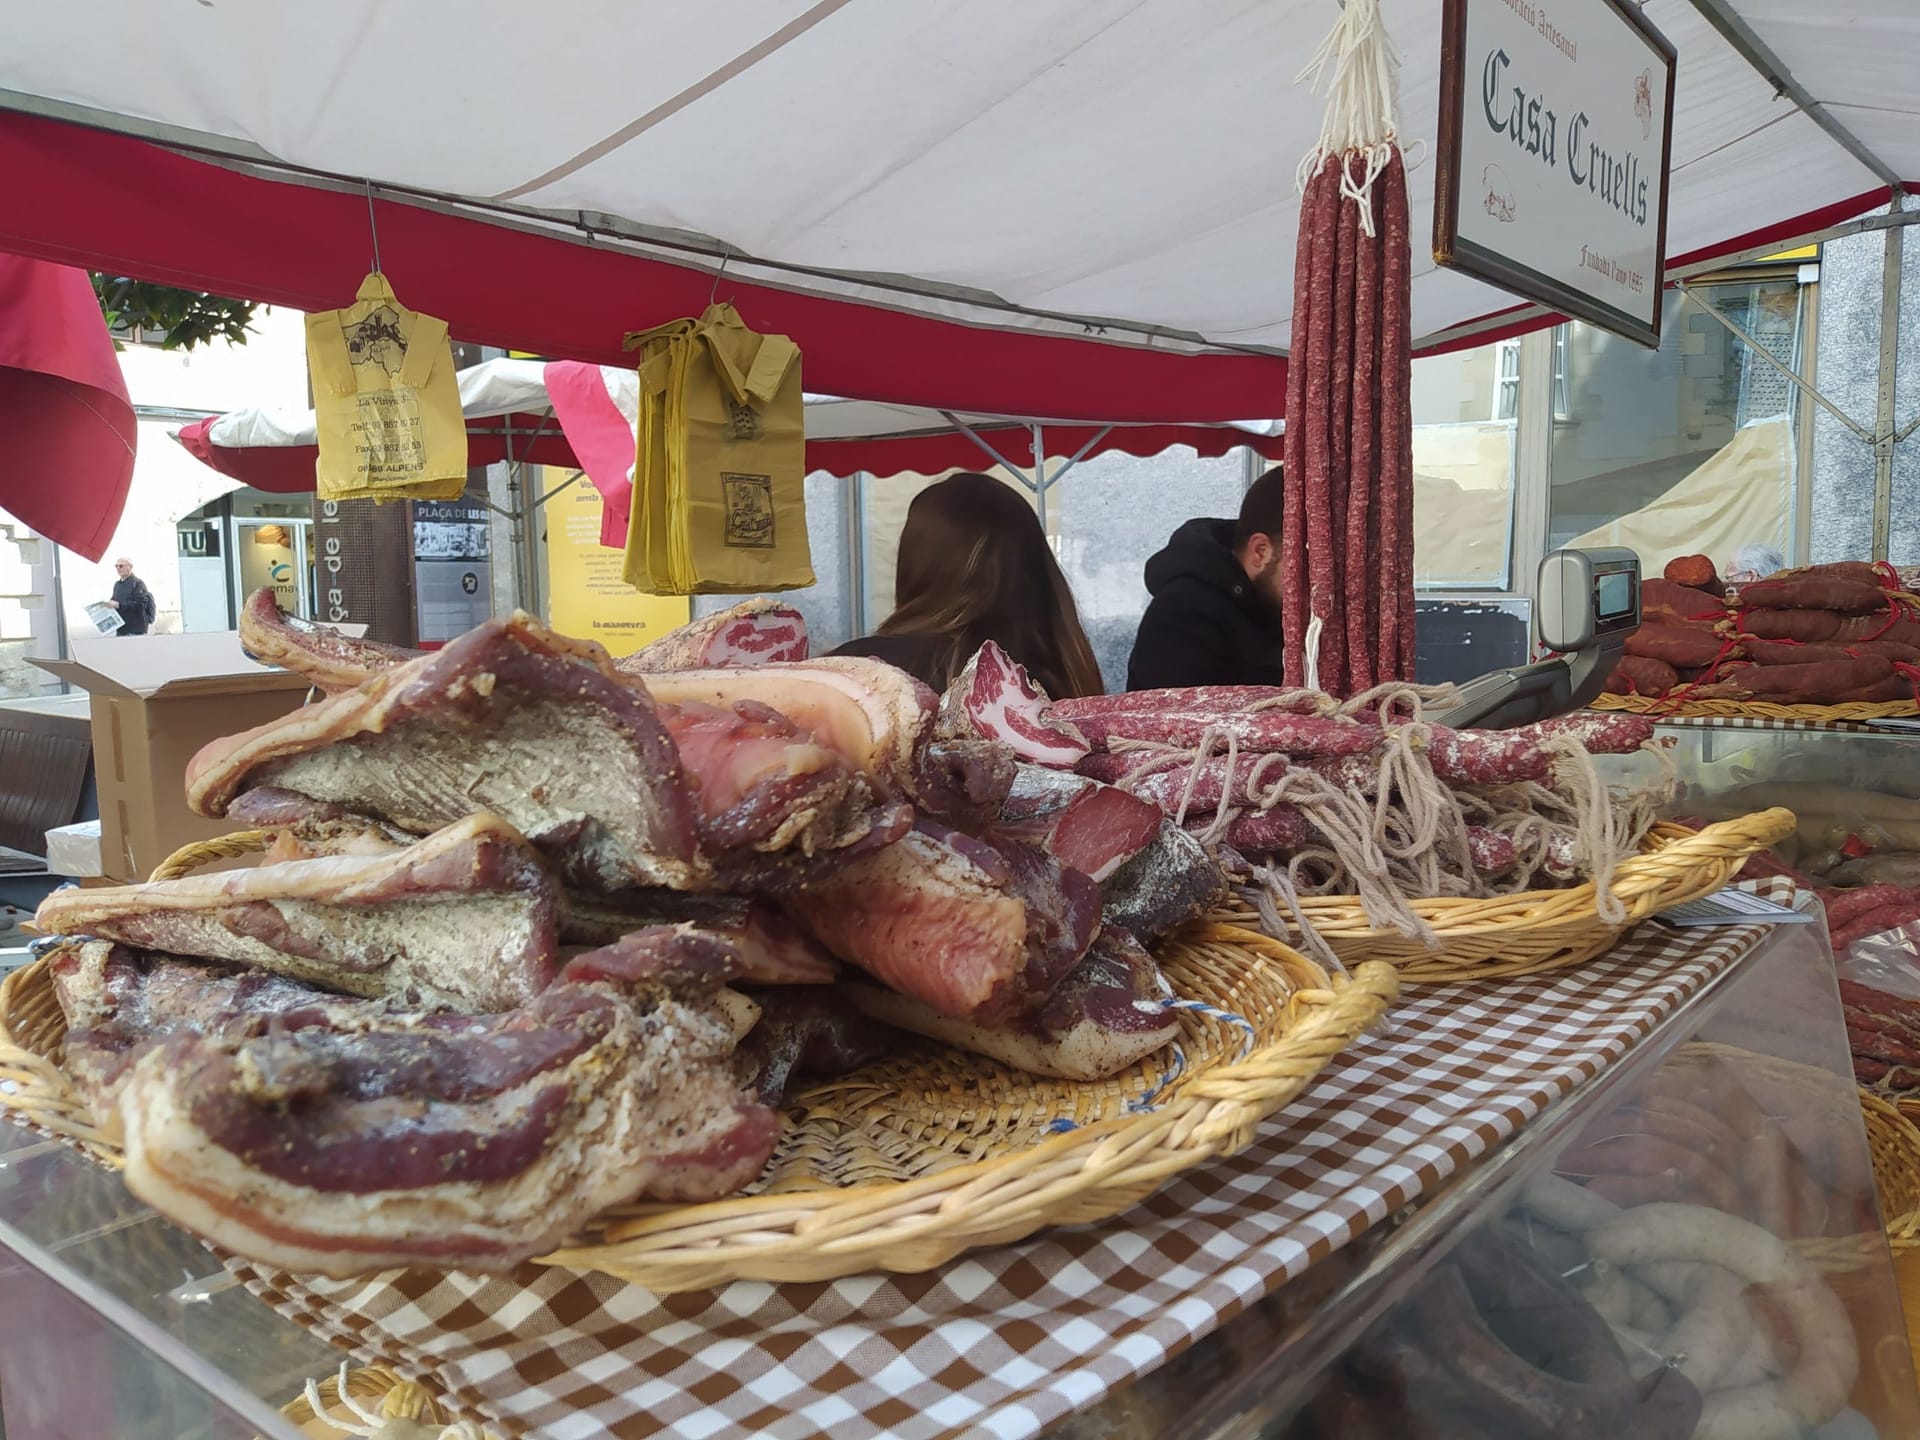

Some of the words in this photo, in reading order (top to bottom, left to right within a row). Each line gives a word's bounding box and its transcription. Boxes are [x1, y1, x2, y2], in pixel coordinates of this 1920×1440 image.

[1538, 9, 1577, 64] Artesanal
[1483, 48, 1557, 168] Casa
[1567, 111, 1650, 227] Cruells
[1579, 244, 1610, 278] Fundada
[358, 398, 370, 407] La
[385, 461, 424, 472] ALPENS
[418, 507, 453, 520] PLAÇA
[455, 509, 466, 518] DE
[467, 509, 479, 519] LES
